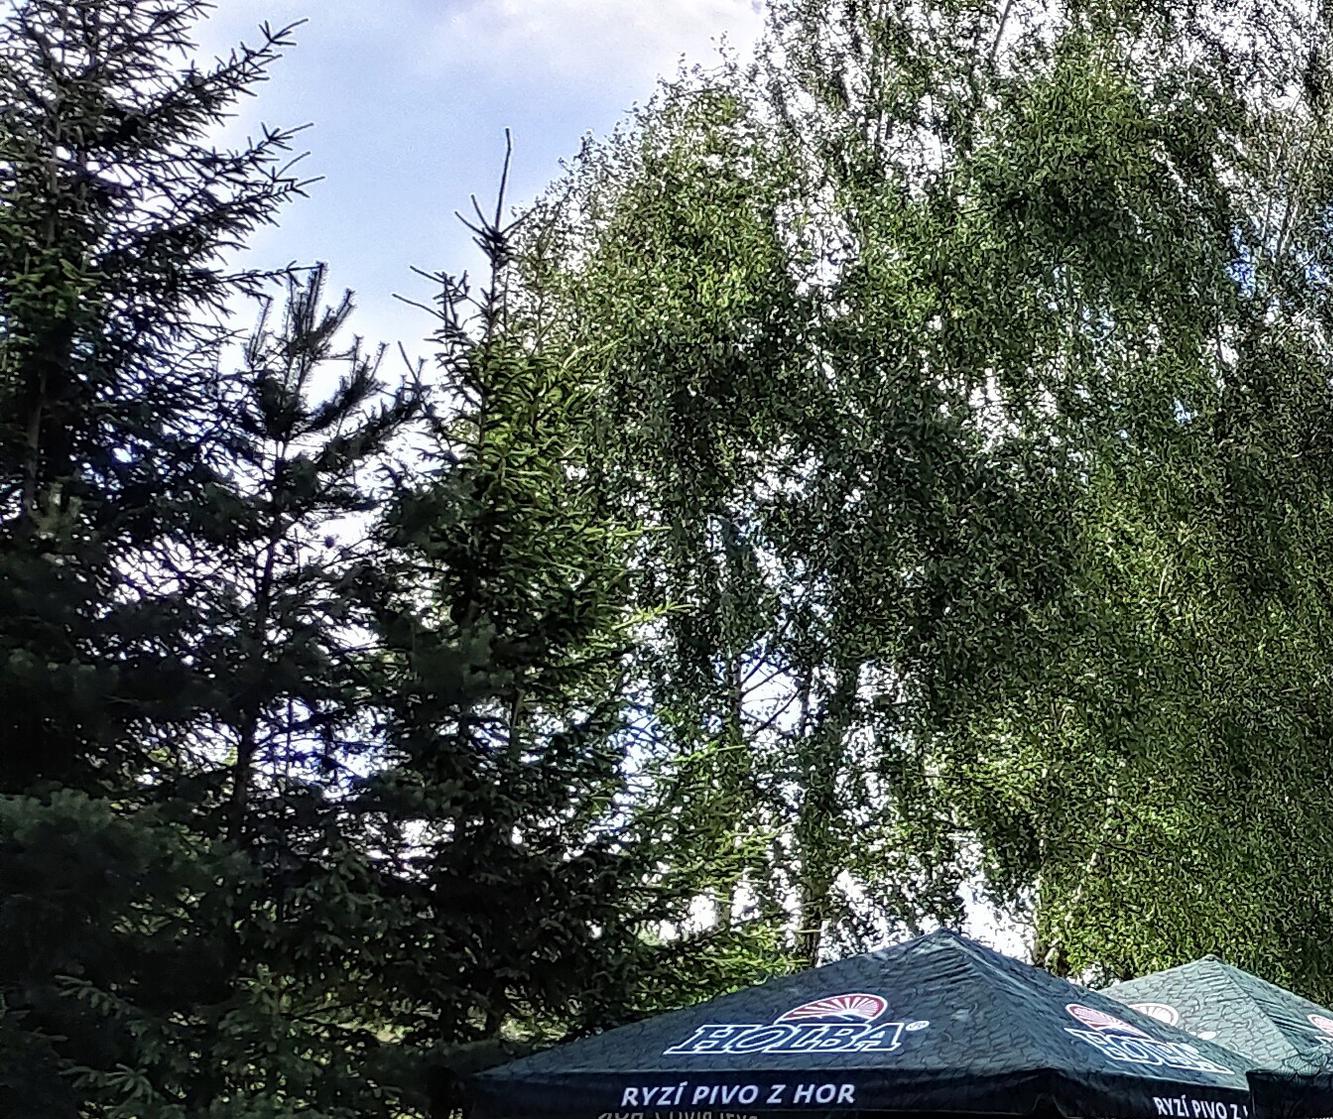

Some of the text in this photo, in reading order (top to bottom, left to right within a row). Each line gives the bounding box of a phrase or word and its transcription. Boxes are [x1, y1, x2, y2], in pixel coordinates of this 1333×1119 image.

[663, 1022, 905, 1055] HOLBA
[621, 1081, 856, 1107] RYZÍ PIVO Z HOR
[1152, 1094, 1190, 1118] RYZÍ
[1191, 1100, 1228, 1119] PIVO
